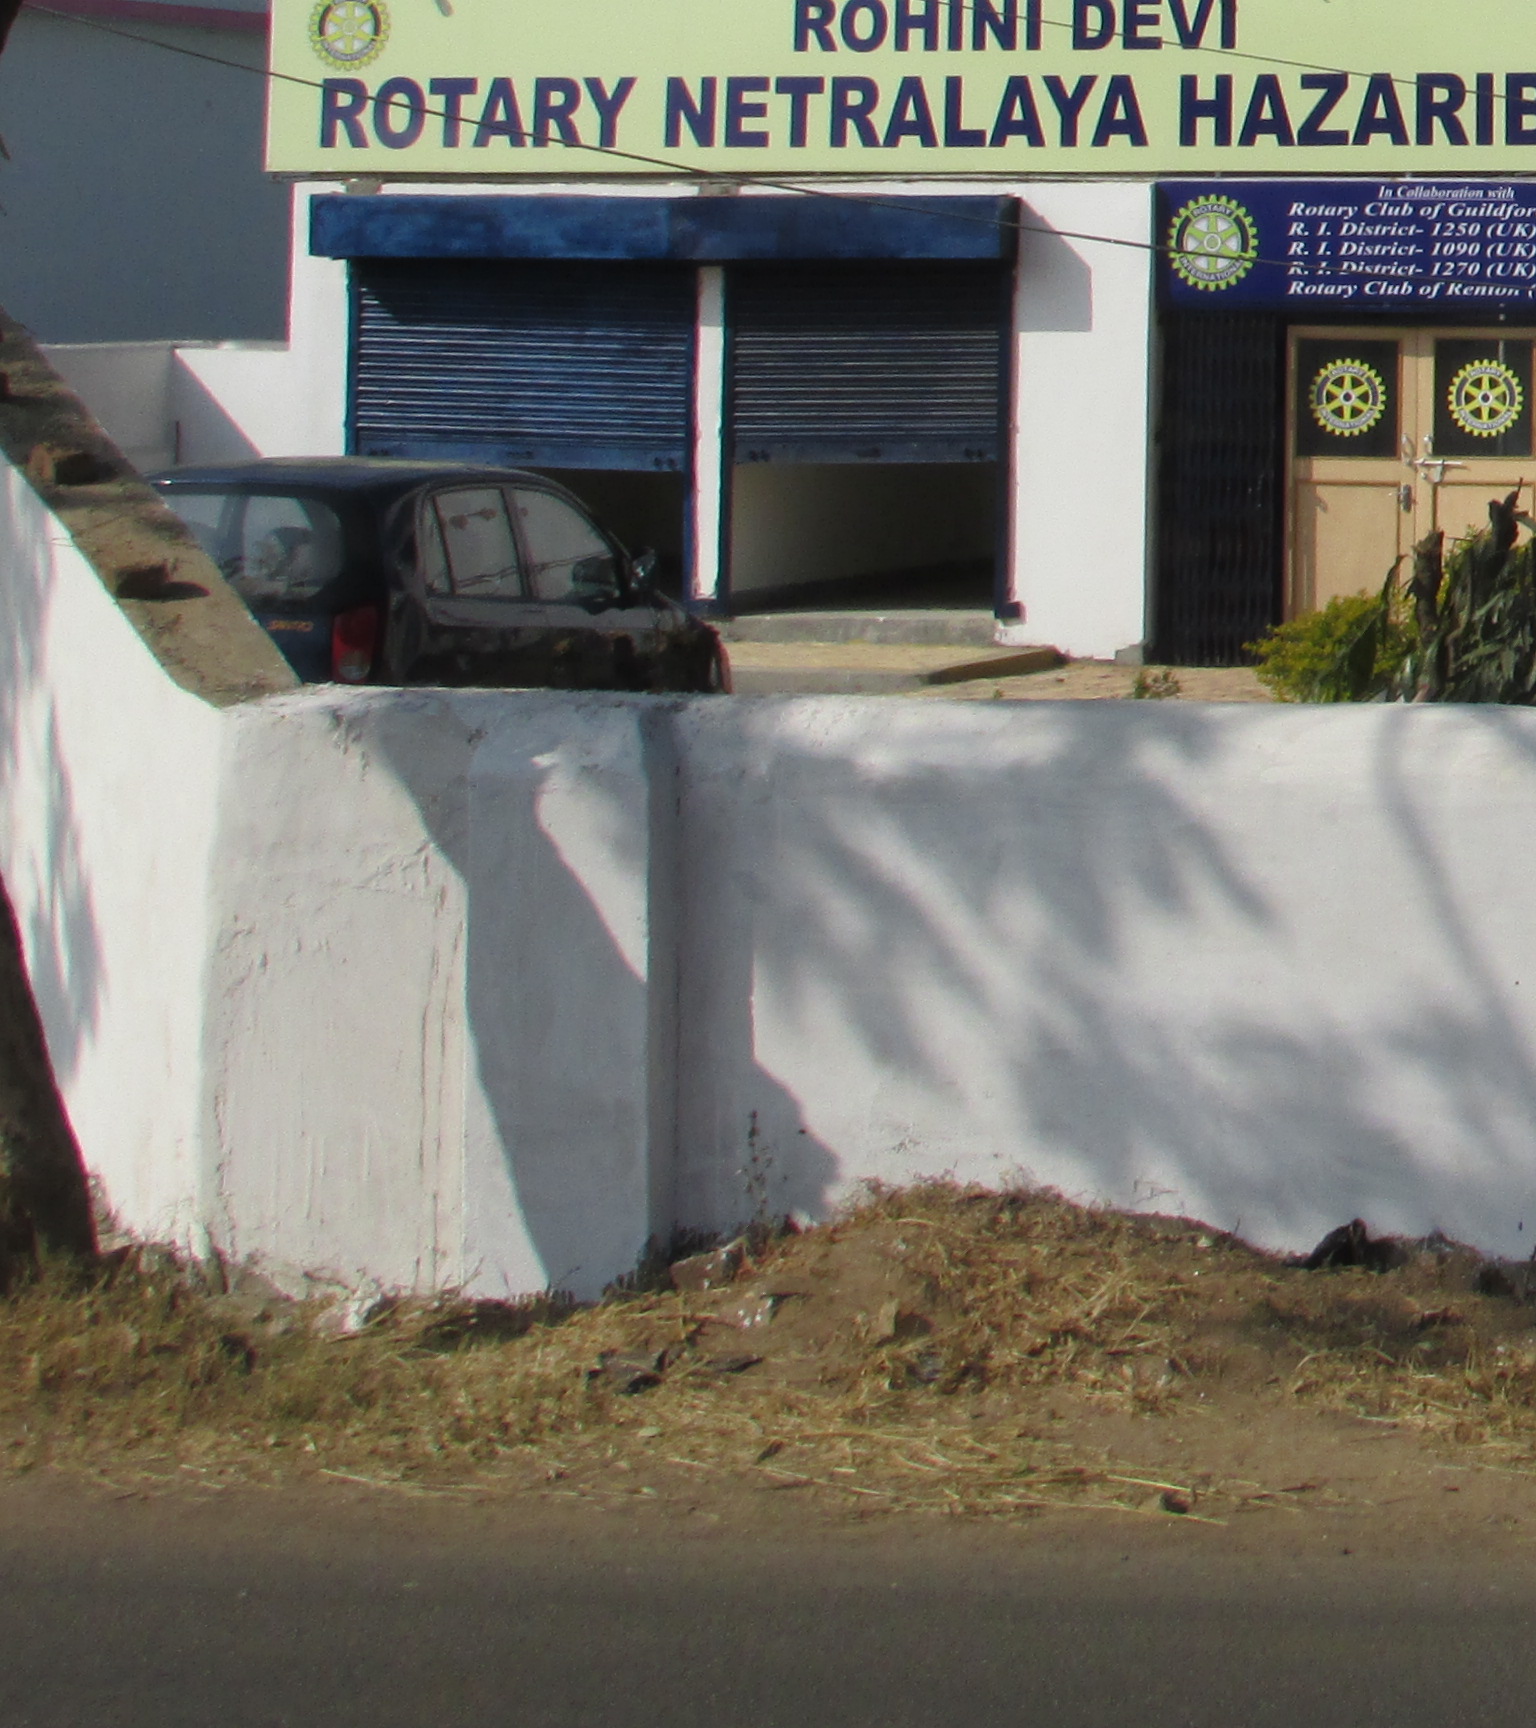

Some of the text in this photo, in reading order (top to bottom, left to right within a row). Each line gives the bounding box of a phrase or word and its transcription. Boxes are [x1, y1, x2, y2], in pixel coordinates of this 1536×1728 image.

[319, 76, 638, 149] ROTARY
[664, 75, 1148, 149] NETRALAYA
[1378, 185, 1515, 200] In Collaboration with
[1288, 202, 1358, 220] Rotary
[1364, 202, 1413, 217] Club
[1419, 202, 1446, 220] of
[1288, 222, 1309, 236] R.
[1339, 221, 1424, 237] District-
[1431, 222, 1481, 237] 1250
[1486, 223, 1536, 240] (UK)
[1288, 241, 1309, 256] R.
[1339, 241, 1424, 256] District-
[1431, 242, 1481, 257] 1090
[1486, 242, 1536, 259] (UK)
[1339, 260, 1424, 277] District-
[1431, 261, 1481, 277] 1270
[1486, 262, 1536, 279] (UK)
[1288, 280, 1358, 298] Rotary
[1363, 280, 1413, 296] Club
[1419, 281, 1446, 299] of
